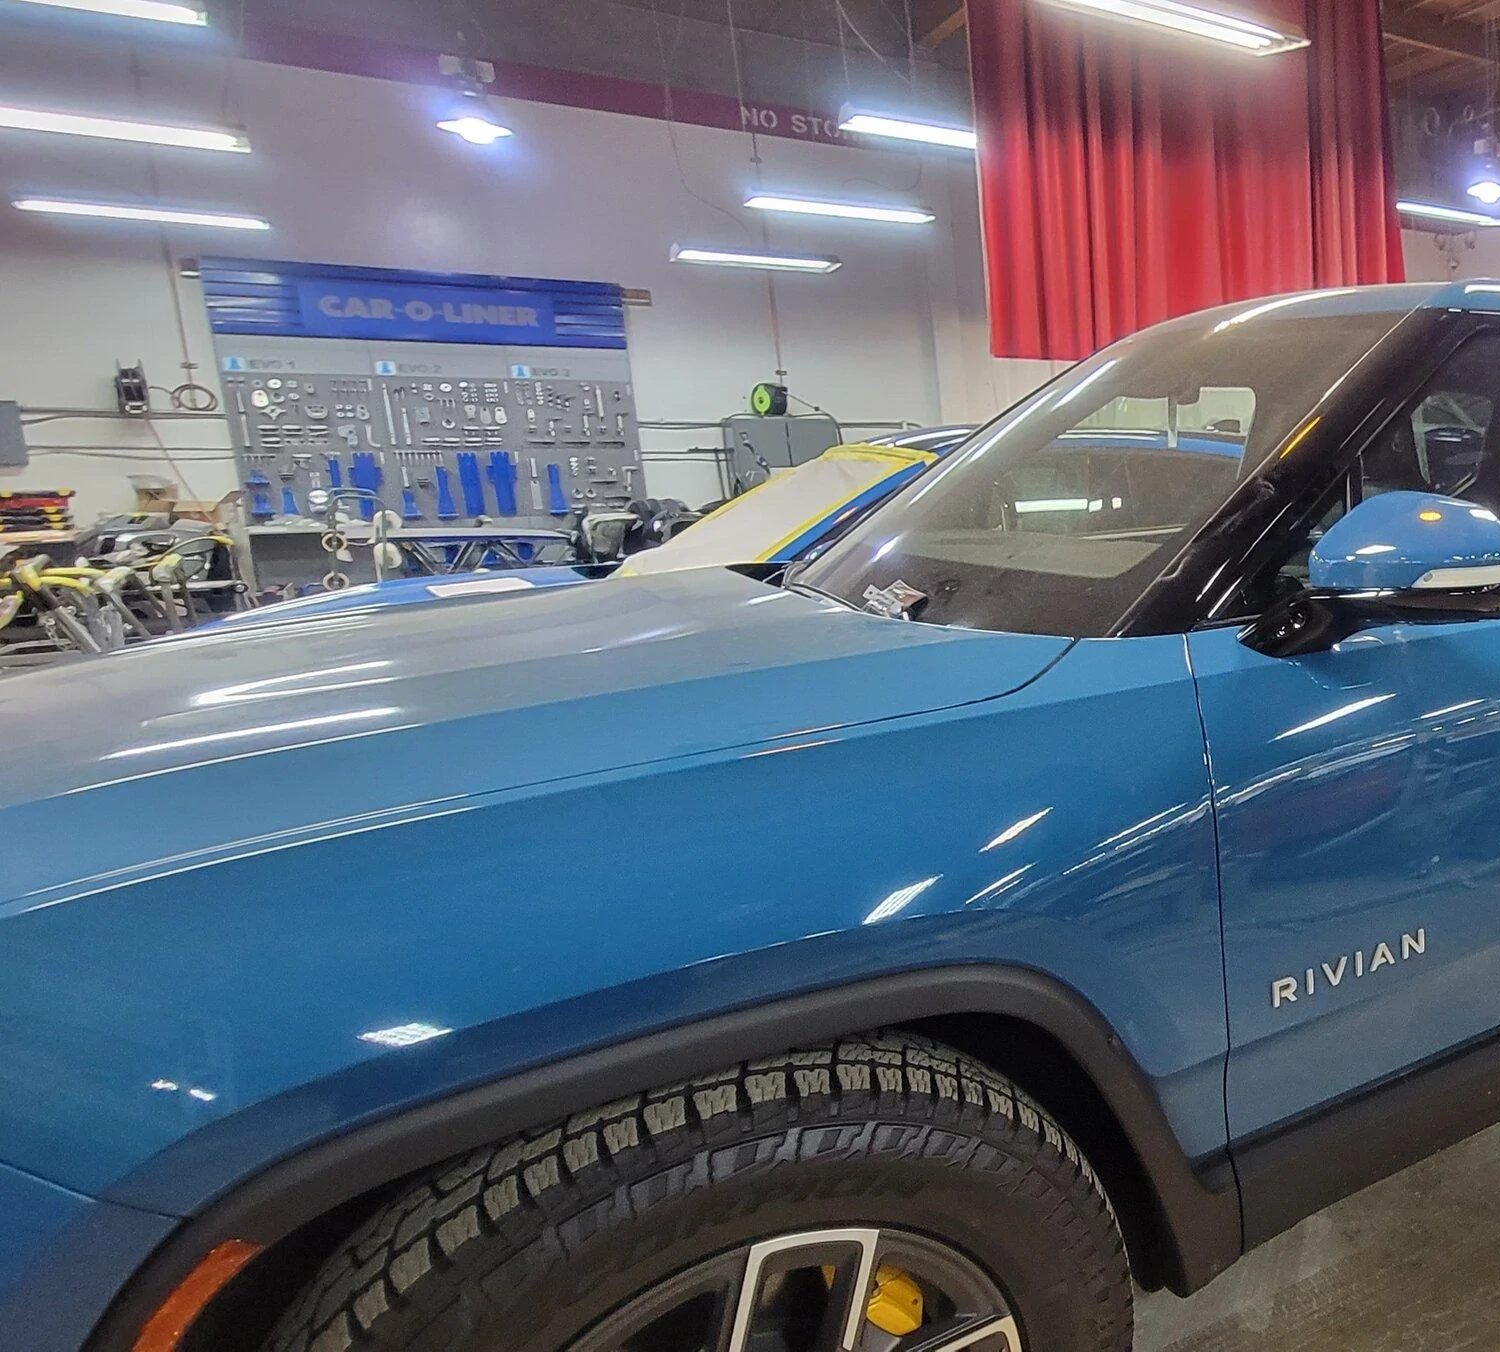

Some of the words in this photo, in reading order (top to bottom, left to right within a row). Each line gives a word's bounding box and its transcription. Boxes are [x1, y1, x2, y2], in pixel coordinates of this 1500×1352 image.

[740, 105, 778, 129] NO
[319, 296, 540, 327] CAR-O-LINER
[1271, 928, 1426, 1009] RIVIAN
